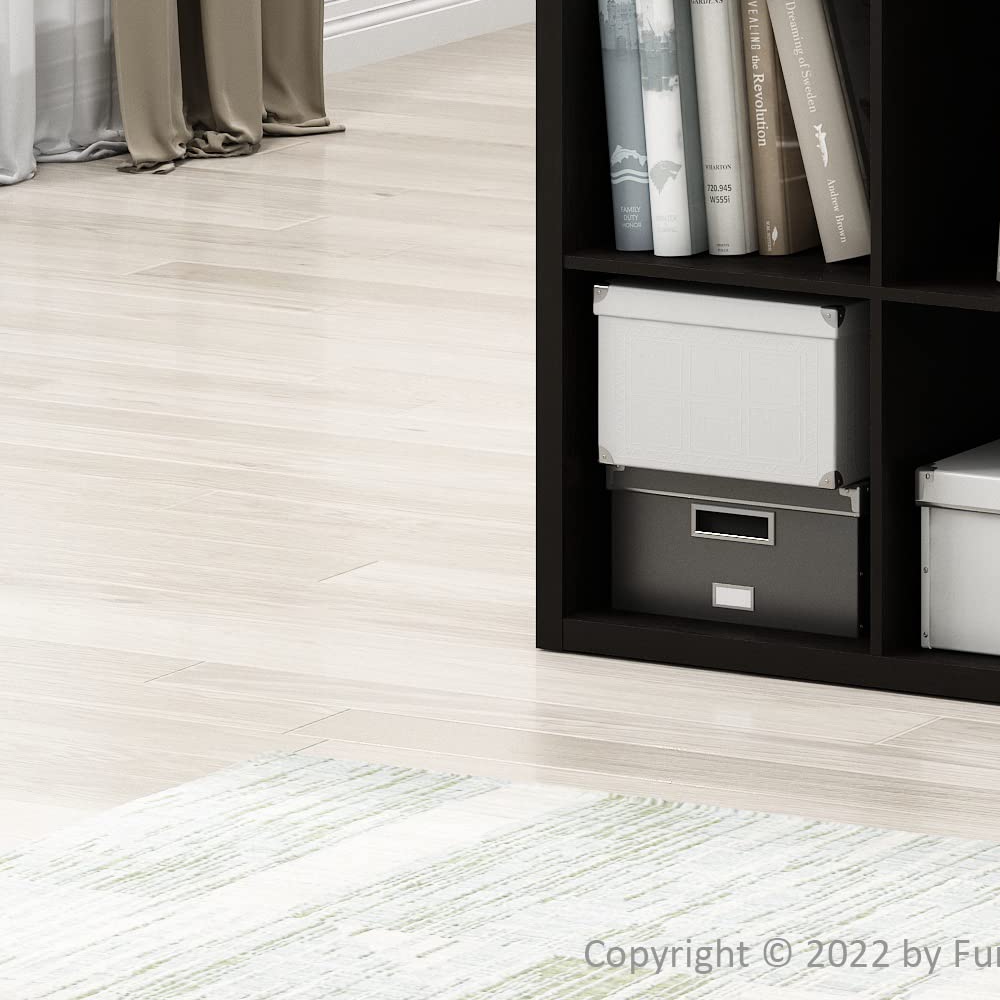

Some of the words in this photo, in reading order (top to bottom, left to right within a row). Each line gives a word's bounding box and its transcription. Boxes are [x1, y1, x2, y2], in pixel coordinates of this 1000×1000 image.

[785, 0, 803, 56] Dreaming
[751, 55, 761, 70] the
[799, 57, 810, 69] of
[802, 68, 817, 114] Sweden
[753, 72, 768, 147] Revolution
[707, 184, 732, 192] 720.945
[827, 178, 840, 213] Andrew
[835, 213, 848, 243] Brown
